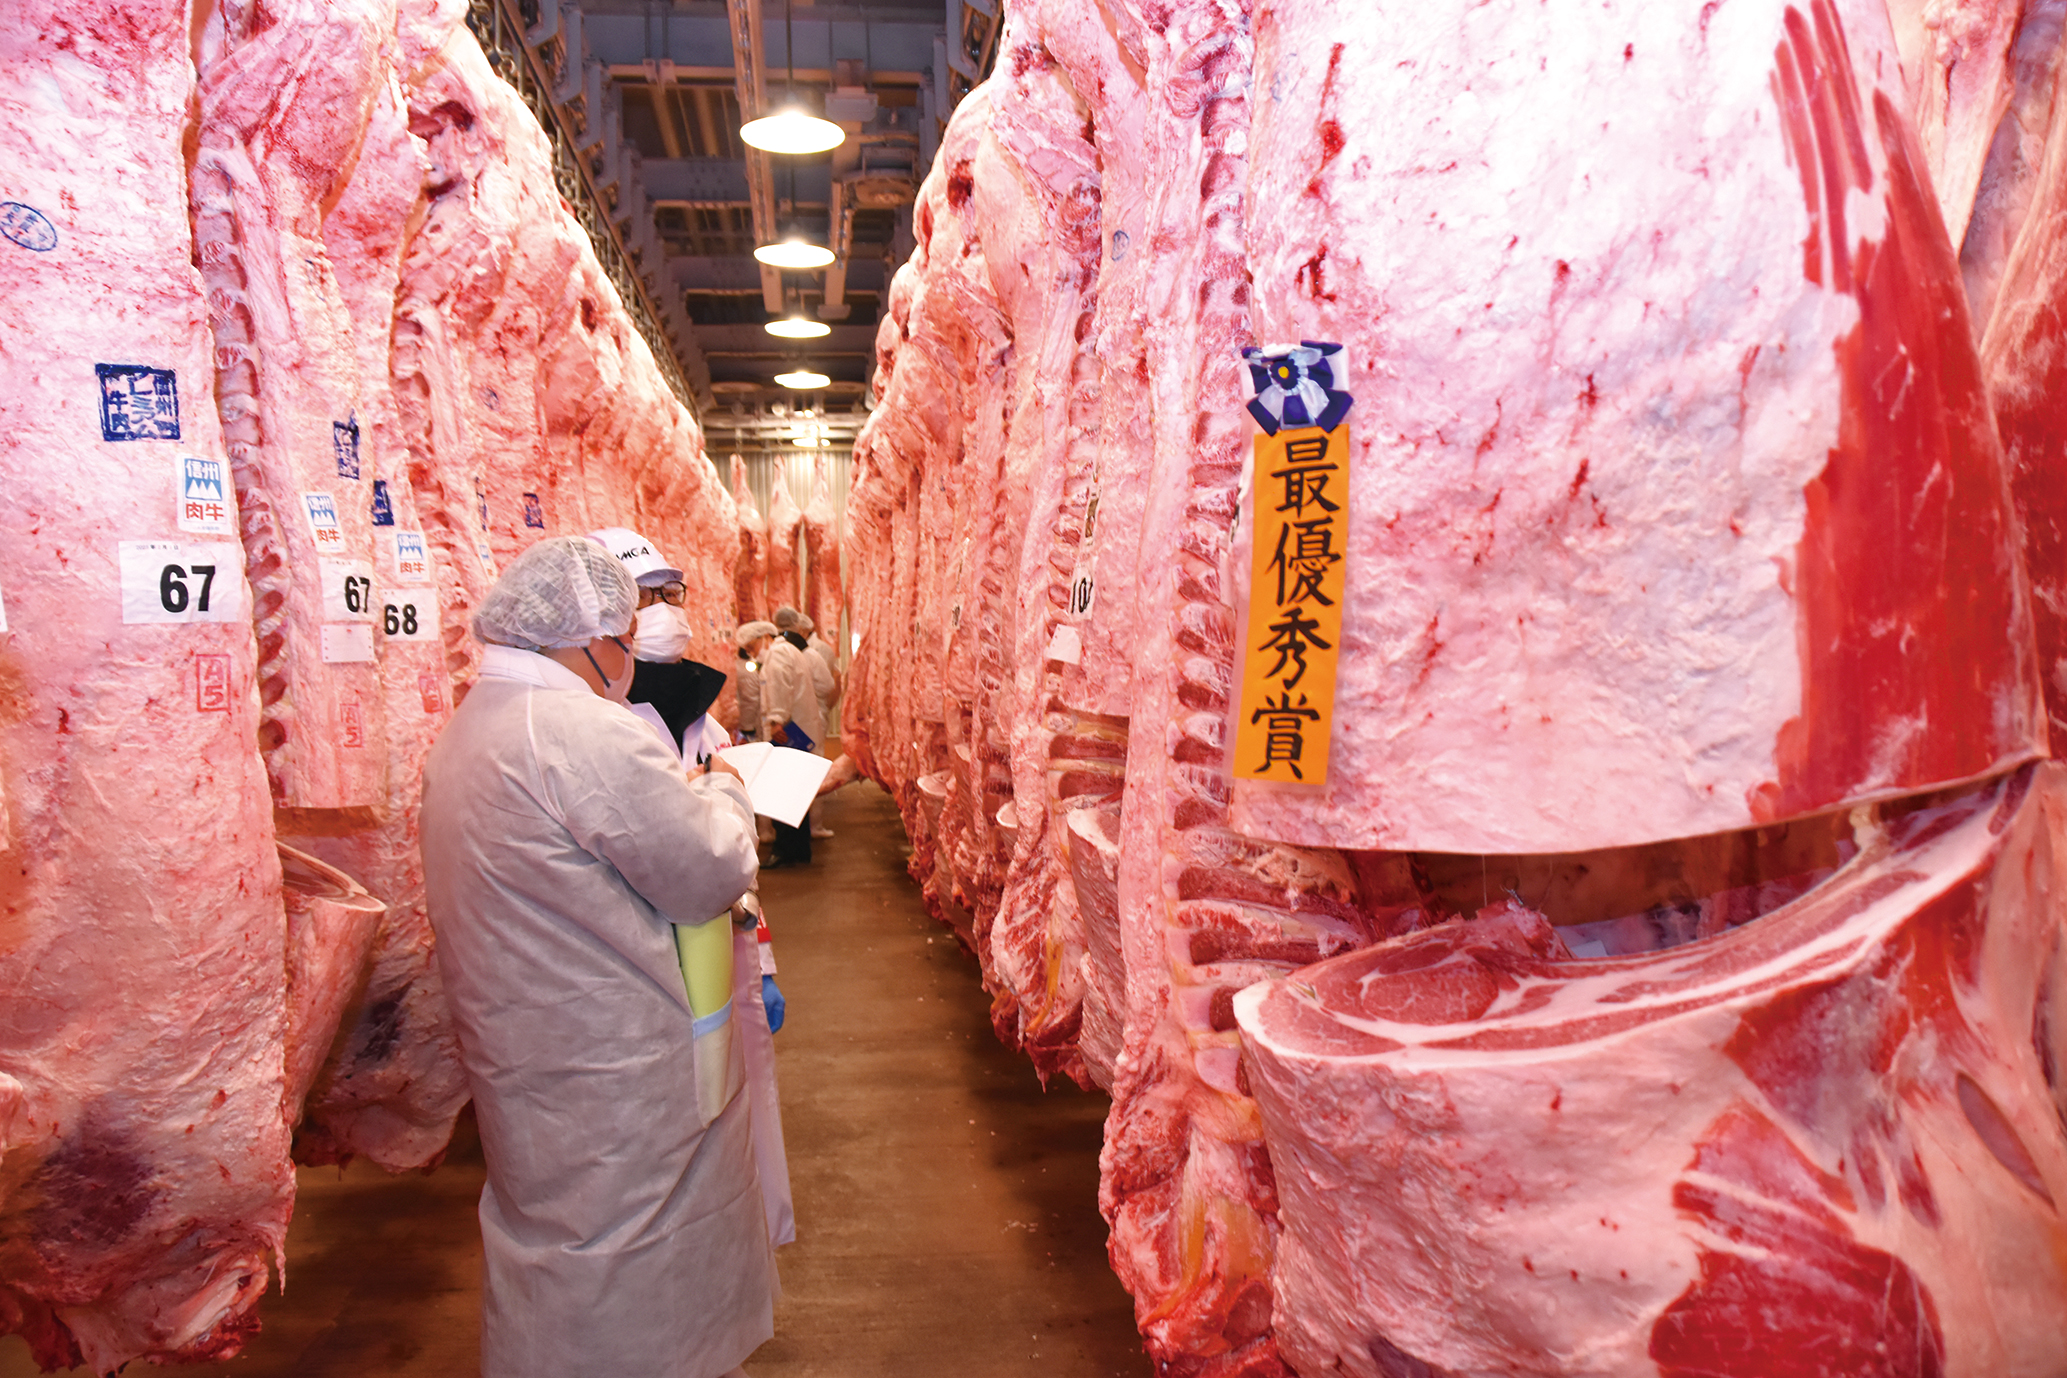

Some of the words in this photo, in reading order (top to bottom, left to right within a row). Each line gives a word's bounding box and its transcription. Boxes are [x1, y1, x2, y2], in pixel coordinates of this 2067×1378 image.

[185, 460, 219, 480] 信州
[185, 502, 224, 521] 肉牛
[160, 564, 216, 613] 67
[344, 576, 371, 613] 67
[383, 604, 418, 635] 68
[1250, 436, 1342, 779] 最優秀賞
